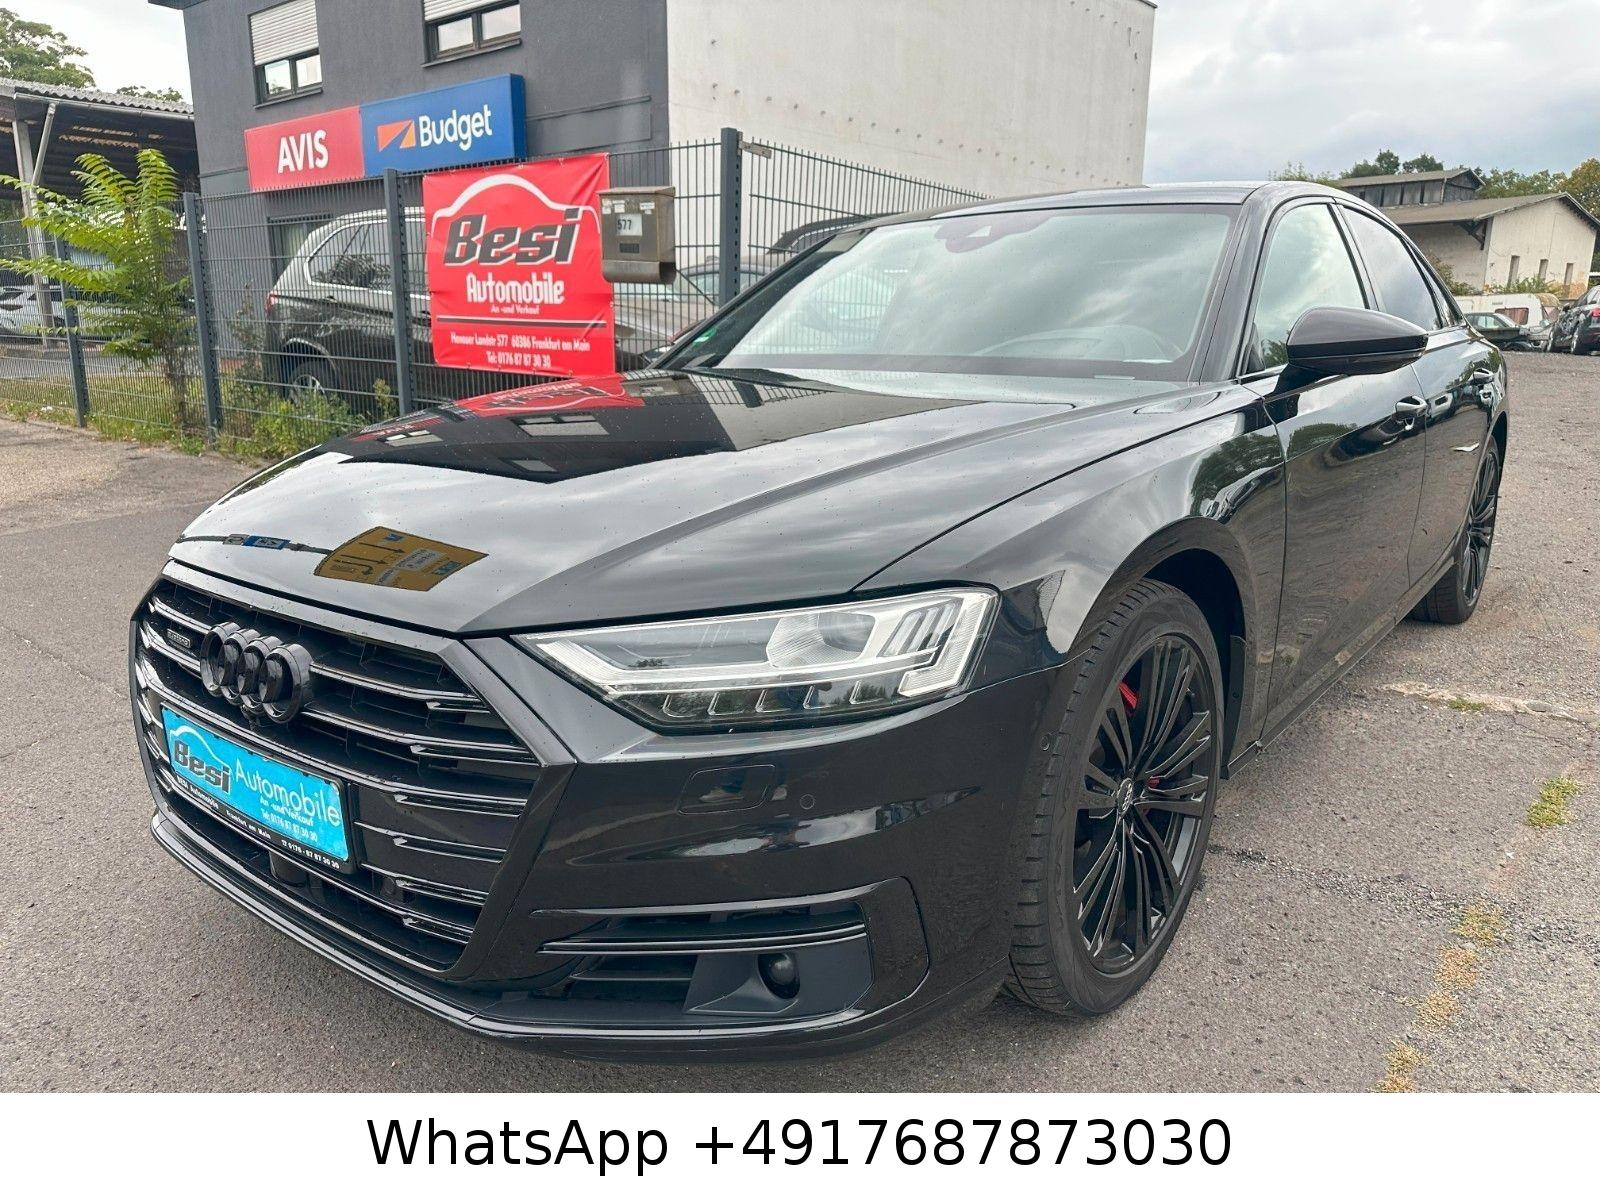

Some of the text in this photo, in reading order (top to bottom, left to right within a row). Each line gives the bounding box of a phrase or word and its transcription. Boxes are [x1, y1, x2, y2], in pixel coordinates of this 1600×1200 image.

[419, 104, 493, 151] Budget
[278, 129, 328, 174] AVIS
[443, 207, 582, 266] Besi
[617, 219, 632, 230] 577
[466, 272, 565, 305] Automobile
[497, 334, 508, 347] 577
[532, 336, 561, 350] Frankfurt
[562, 341, 572, 351] am
[573, 338, 591, 352] Main
[498, 351, 513, 365] 0176
[174, 738, 341, 827] Besi Automobile
